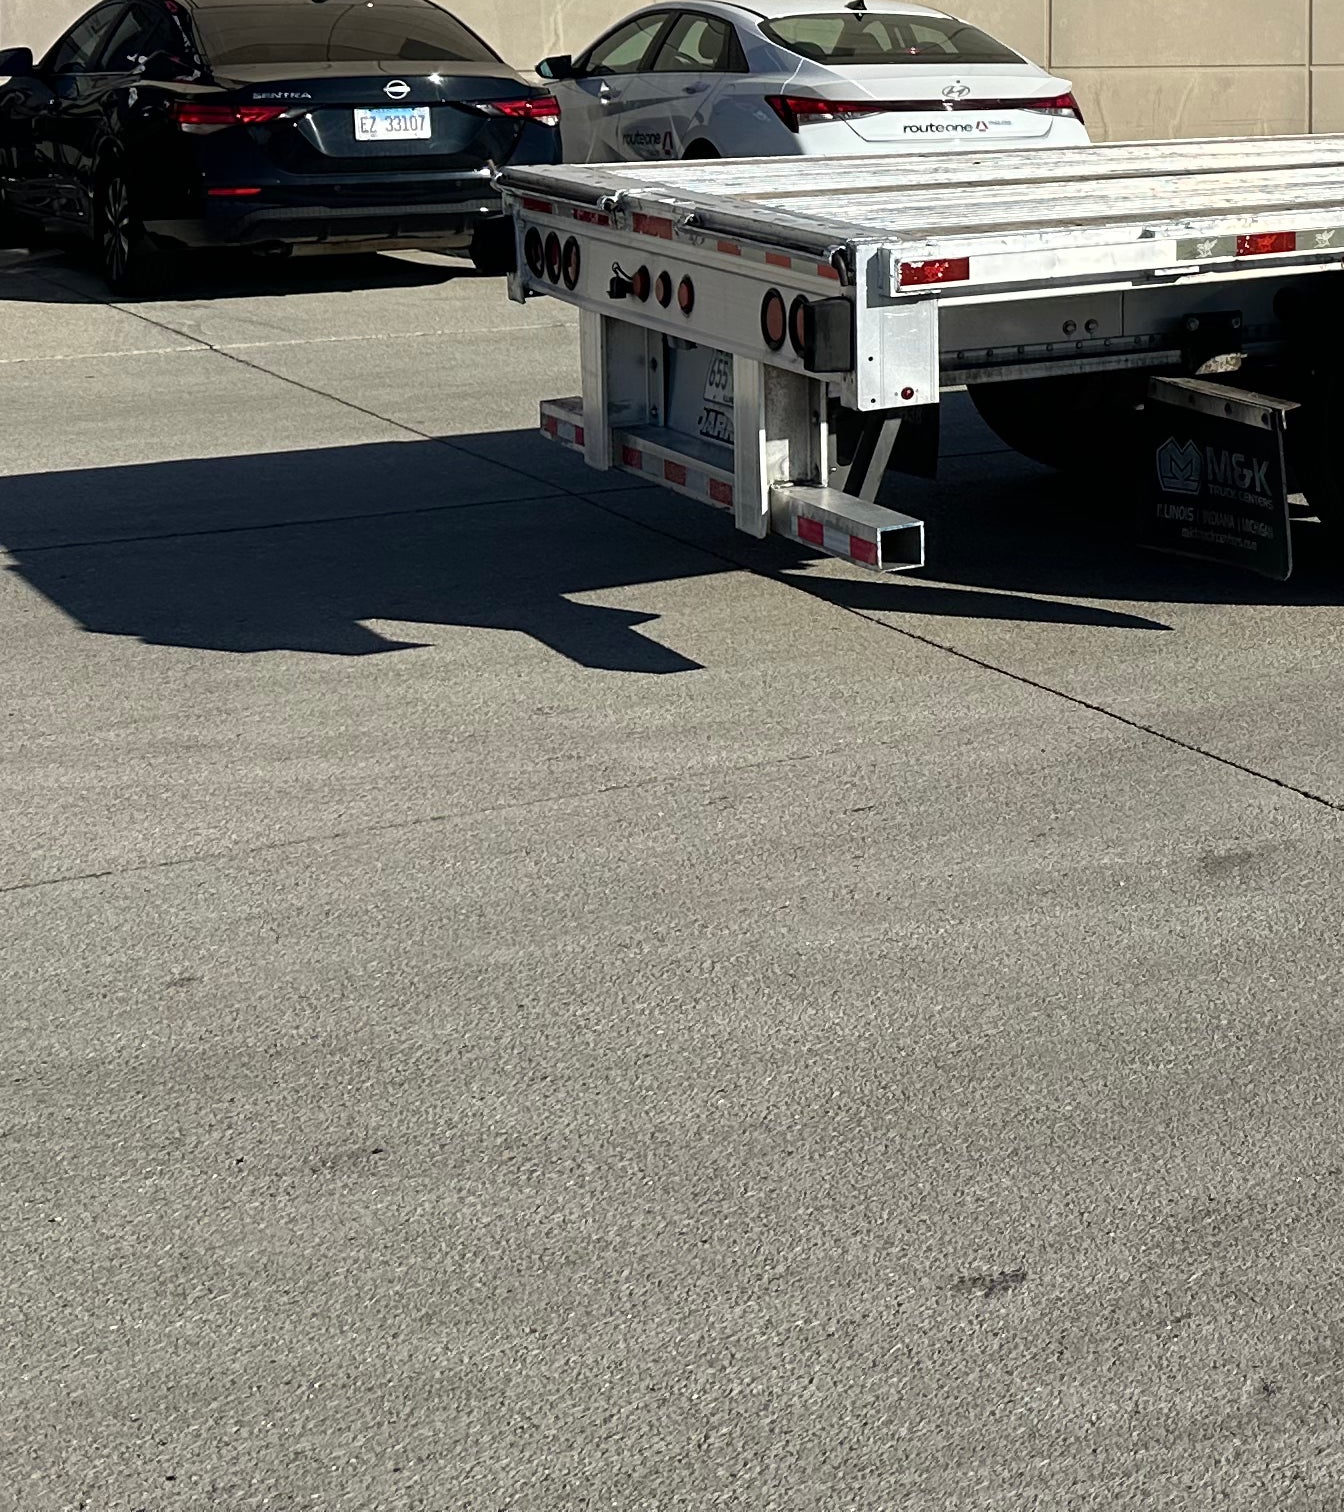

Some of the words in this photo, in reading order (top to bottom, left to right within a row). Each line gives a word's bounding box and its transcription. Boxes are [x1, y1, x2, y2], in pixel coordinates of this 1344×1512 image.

[360, 116, 378, 133] EZ
[385, 114, 426, 132] 33107
[903, 123, 973, 133] routeone
[1206, 446, 1272, 496] M&K
